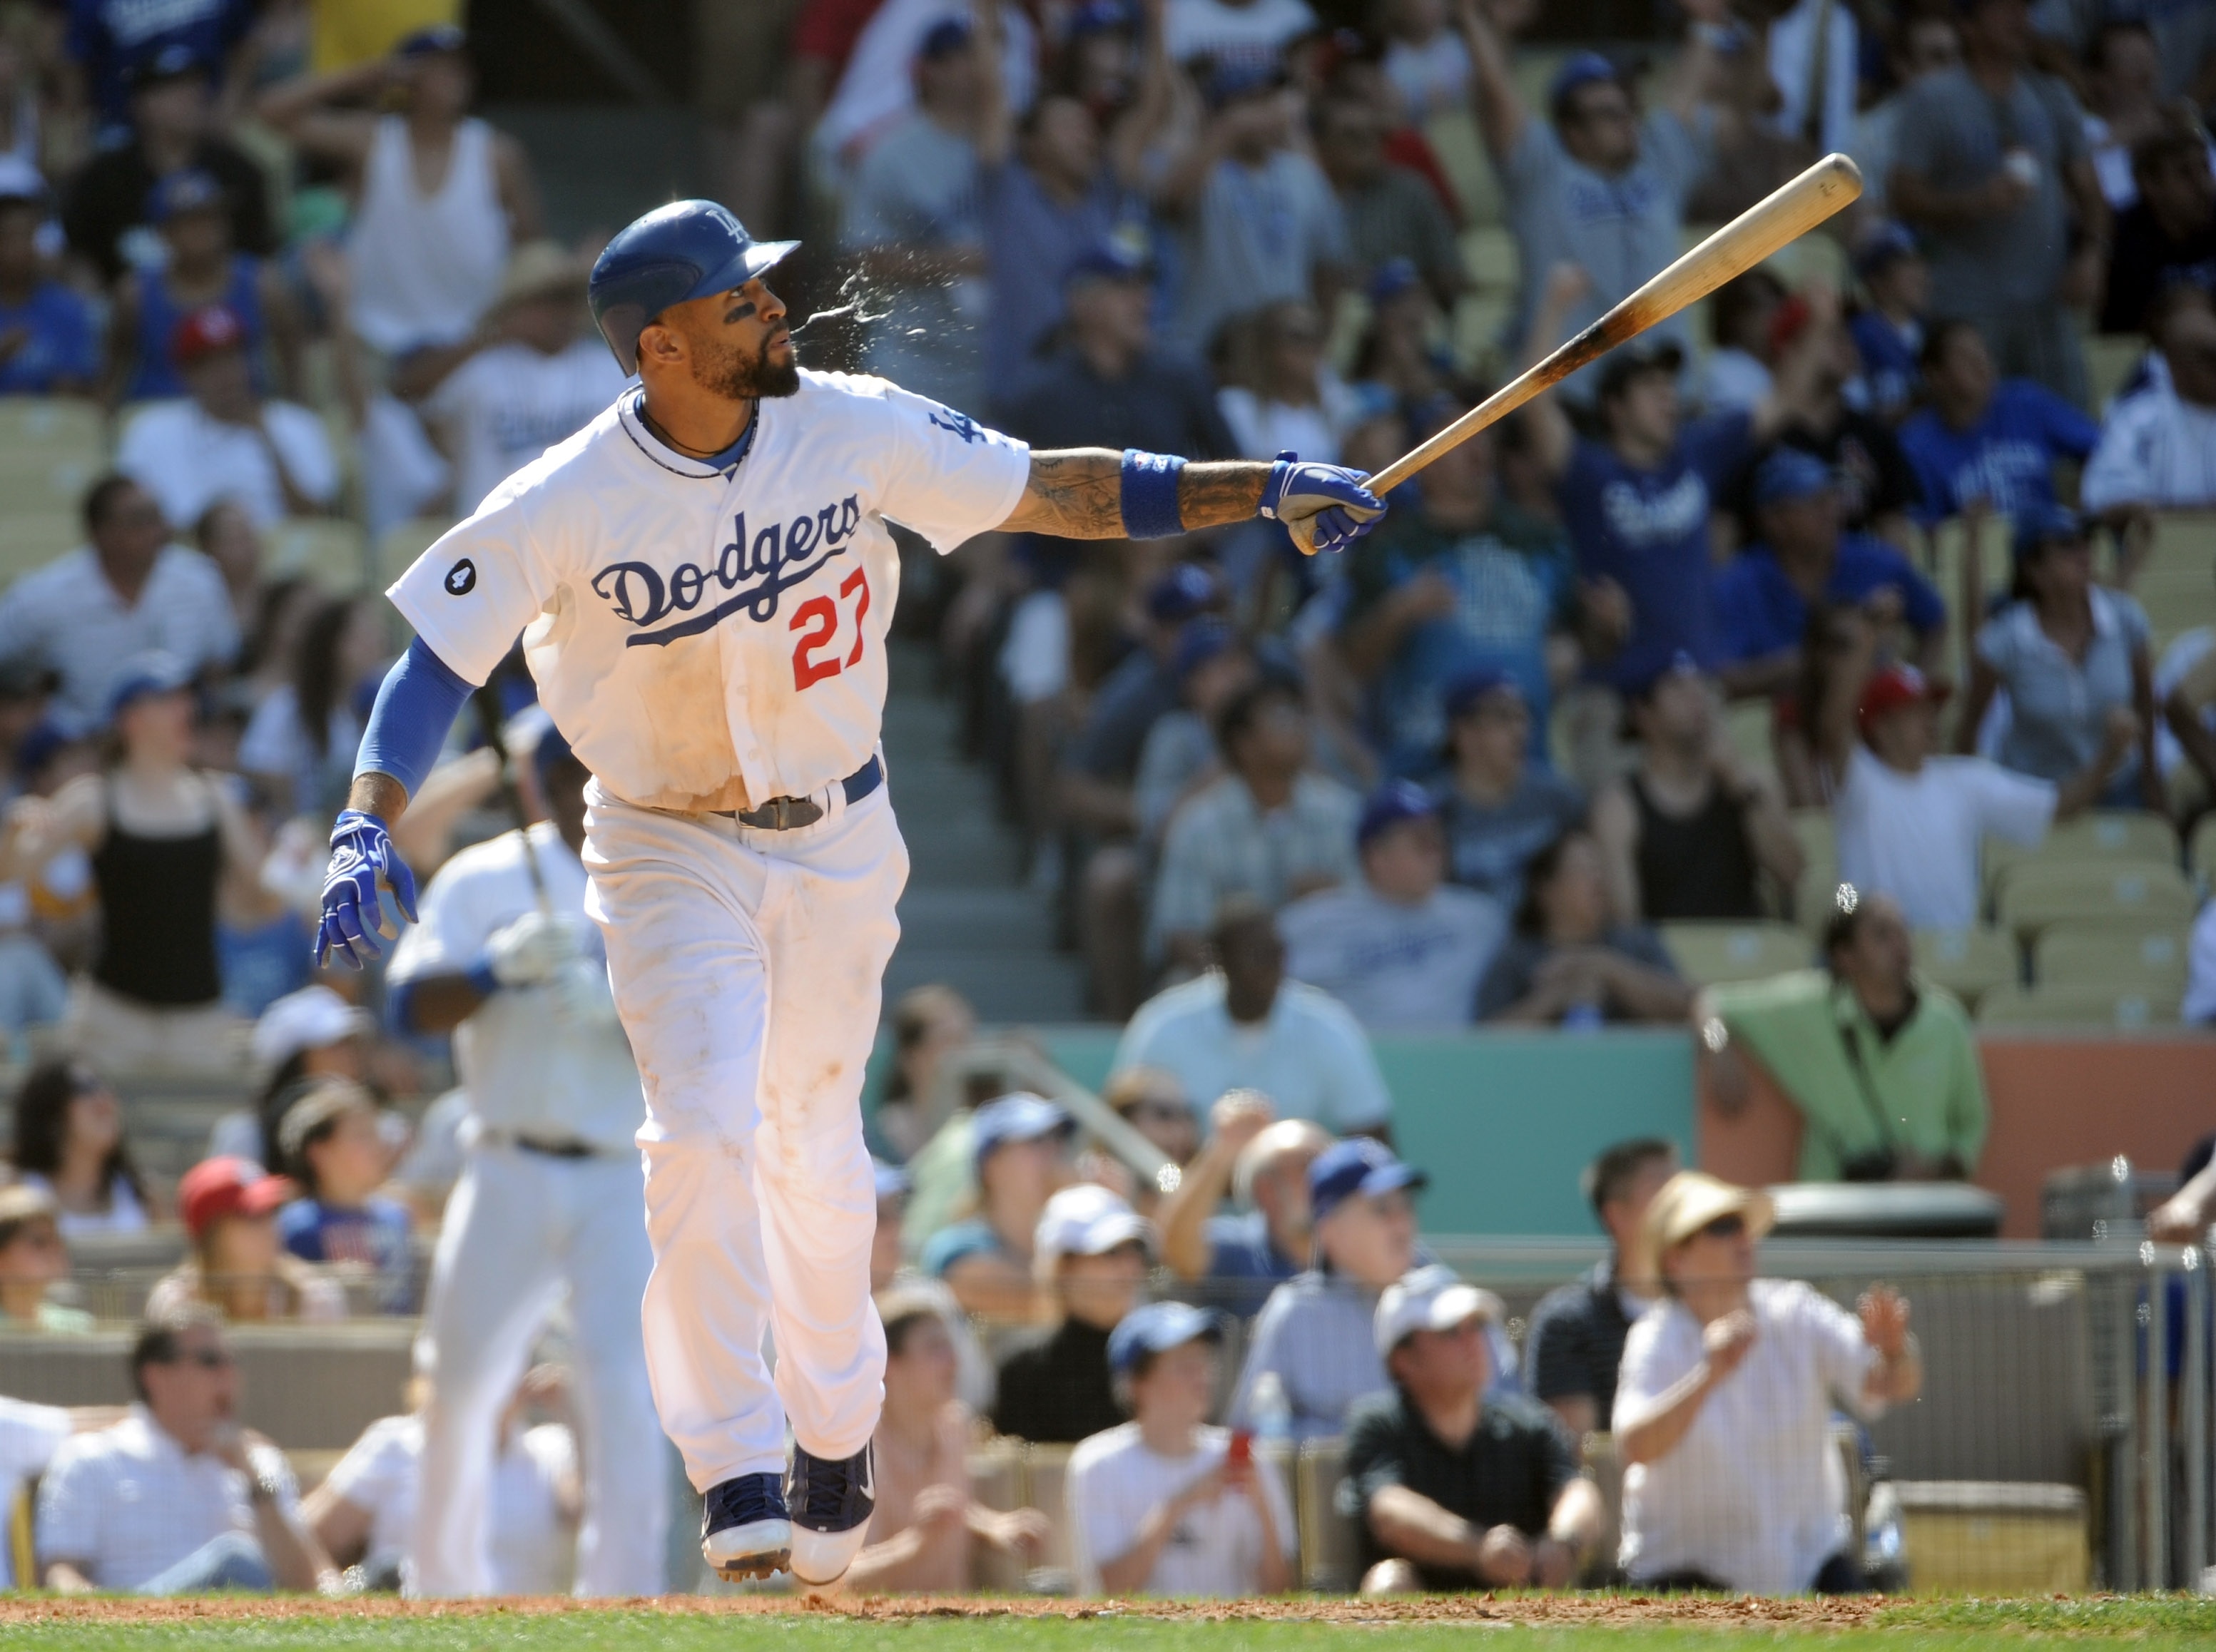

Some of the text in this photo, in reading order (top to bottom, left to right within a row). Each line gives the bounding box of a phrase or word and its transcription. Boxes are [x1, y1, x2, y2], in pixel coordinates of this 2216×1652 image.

[705, 208, 750, 244] LA
[451, 566, 471, 589] 4
[591, 493, 861, 623] Dodgers
[788, 564, 870, 692] 27
